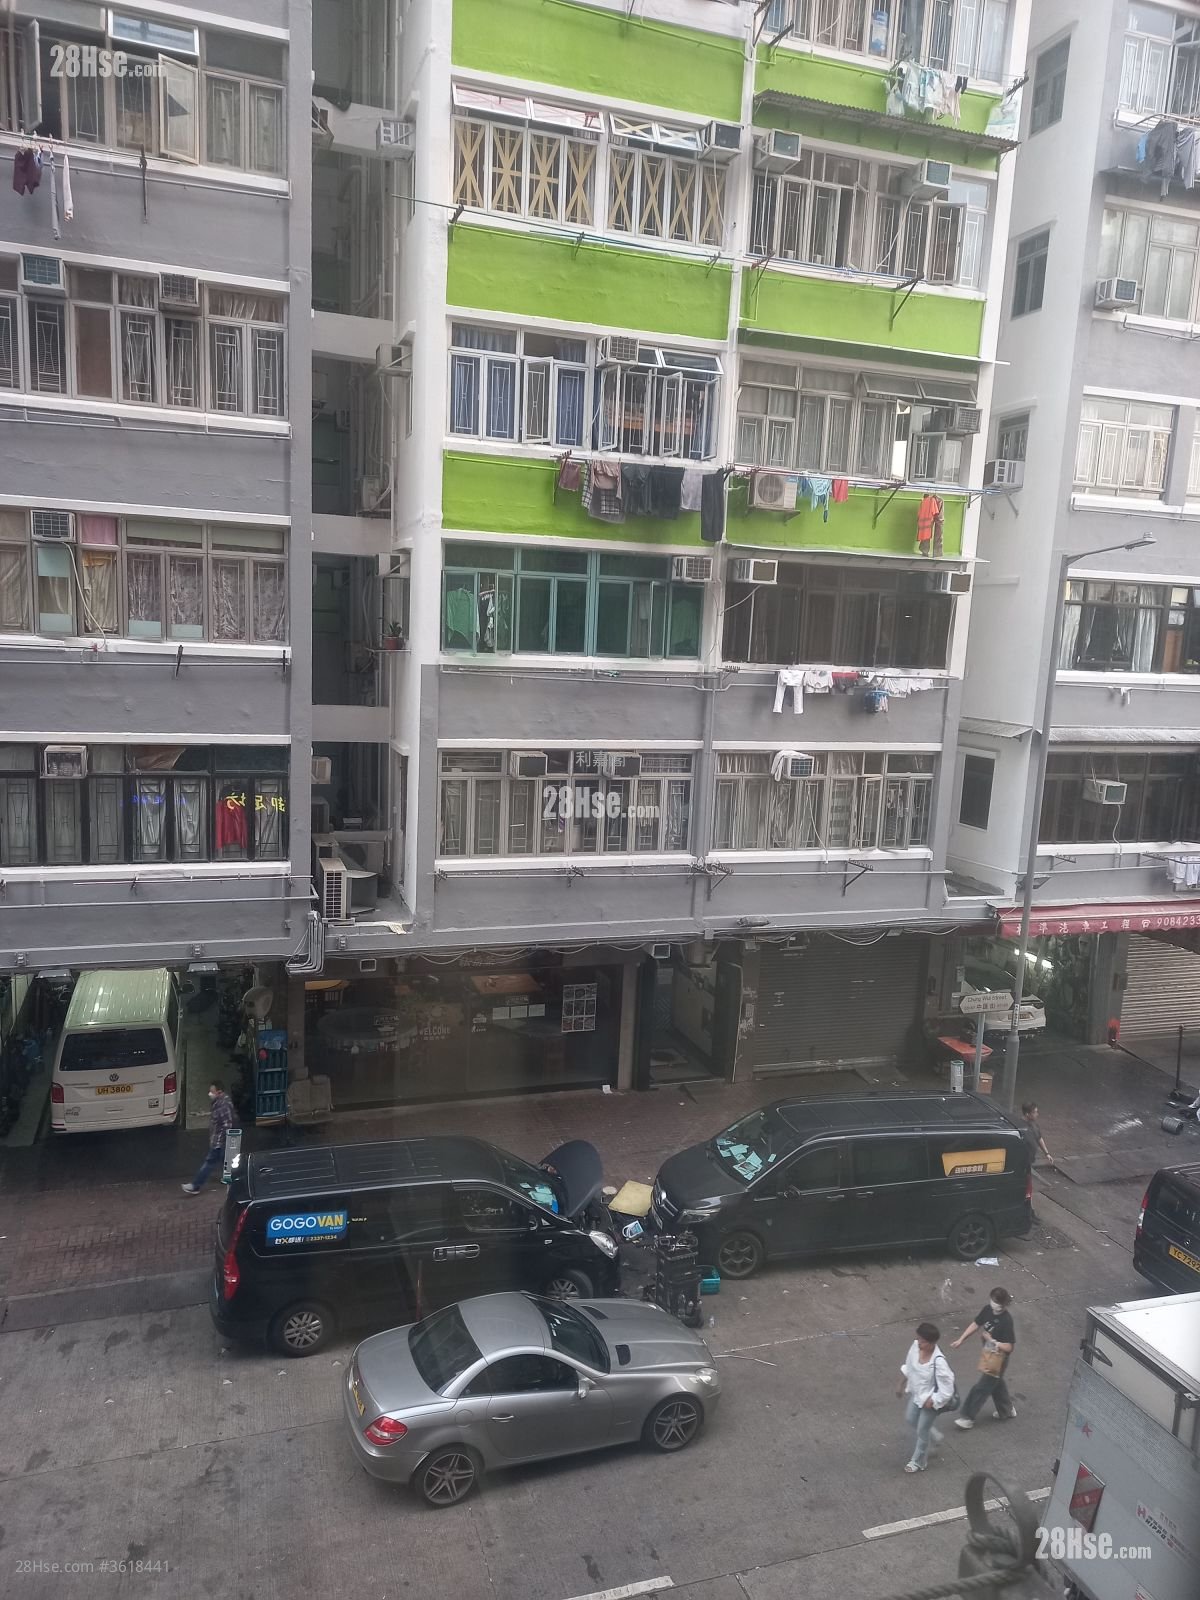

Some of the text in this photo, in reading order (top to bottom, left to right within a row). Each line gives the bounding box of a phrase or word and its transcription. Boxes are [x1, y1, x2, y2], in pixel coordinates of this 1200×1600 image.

[97, 1085, 132, 1095] UH 3800
[270, 1214, 344, 1231] GOGOVAN
